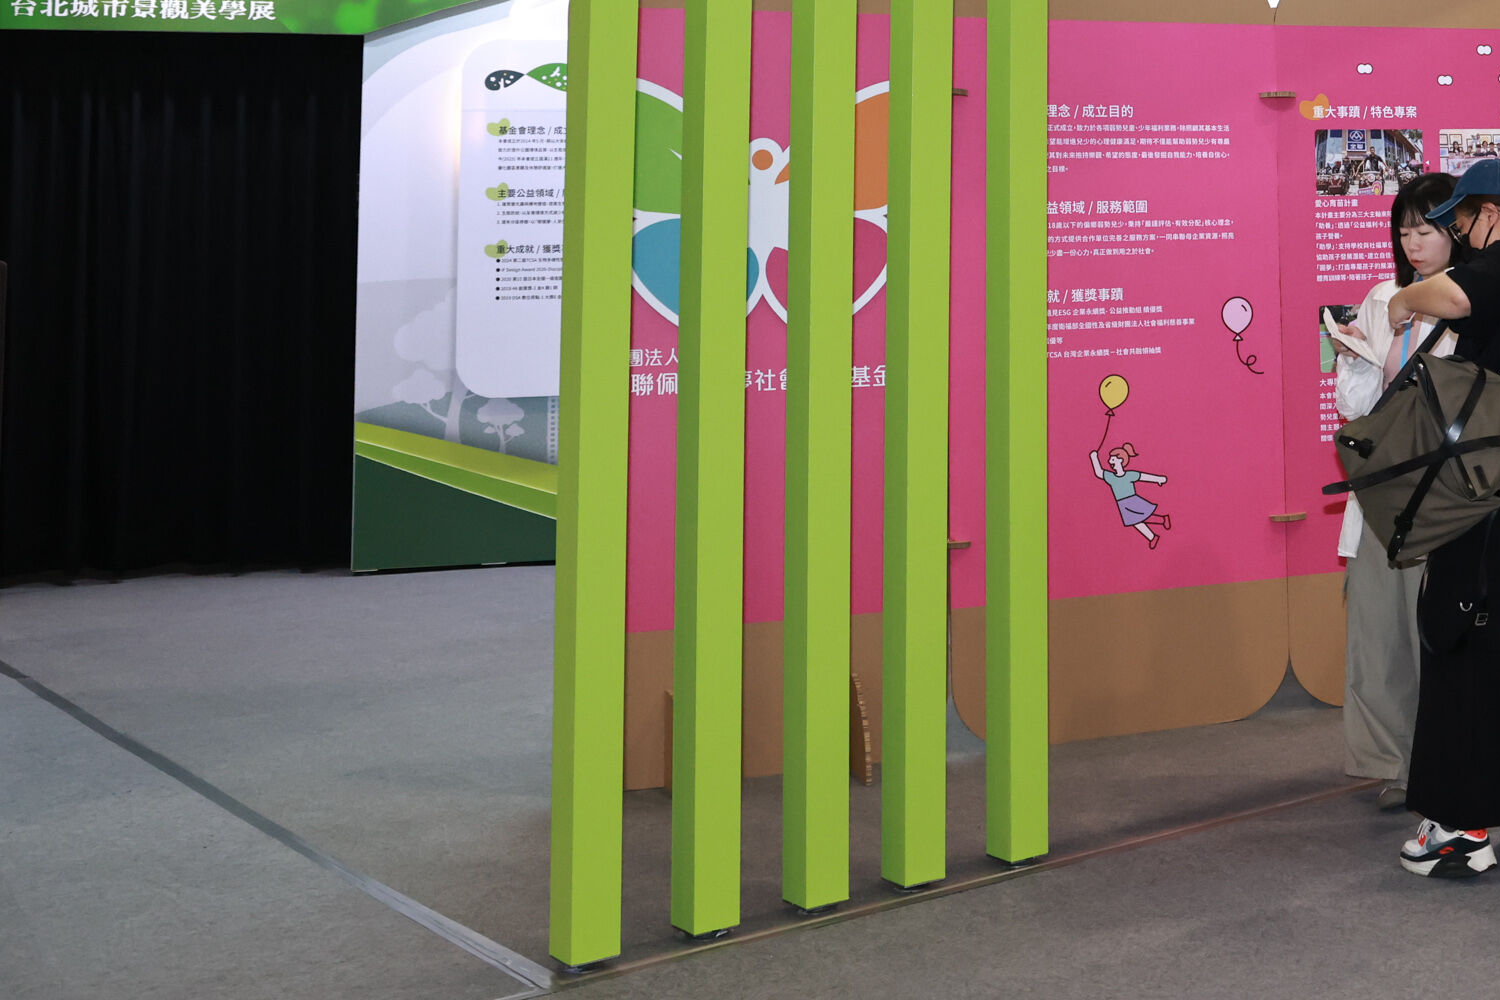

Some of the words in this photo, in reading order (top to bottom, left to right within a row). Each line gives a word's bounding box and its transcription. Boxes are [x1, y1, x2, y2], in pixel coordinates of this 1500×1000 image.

[1073, 104, 1079, 119] /
[1082, 104, 1134, 118] 成立目的
[1312, 105, 1360, 119] 重大事蹟
[1363, 105, 1368, 120] /
[1370, 105, 1417, 119] 特色專案
[499, 126, 546, 135] 基金會理念
[497, 188, 554, 198] 主要公益領域
[1088, 201, 1094, 216] /
[1096, 199, 1149, 214] 服務範圍
[496, 245, 535, 254] 重大成就
[543, 244, 562, 254] 獲獎
[1062, 289, 1068, 305] /
[1071, 287, 1124, 303] 獲獎事蹟
[1047, 337, 1064, 346] 優等
[629, 348, 679, 367] 團法人
